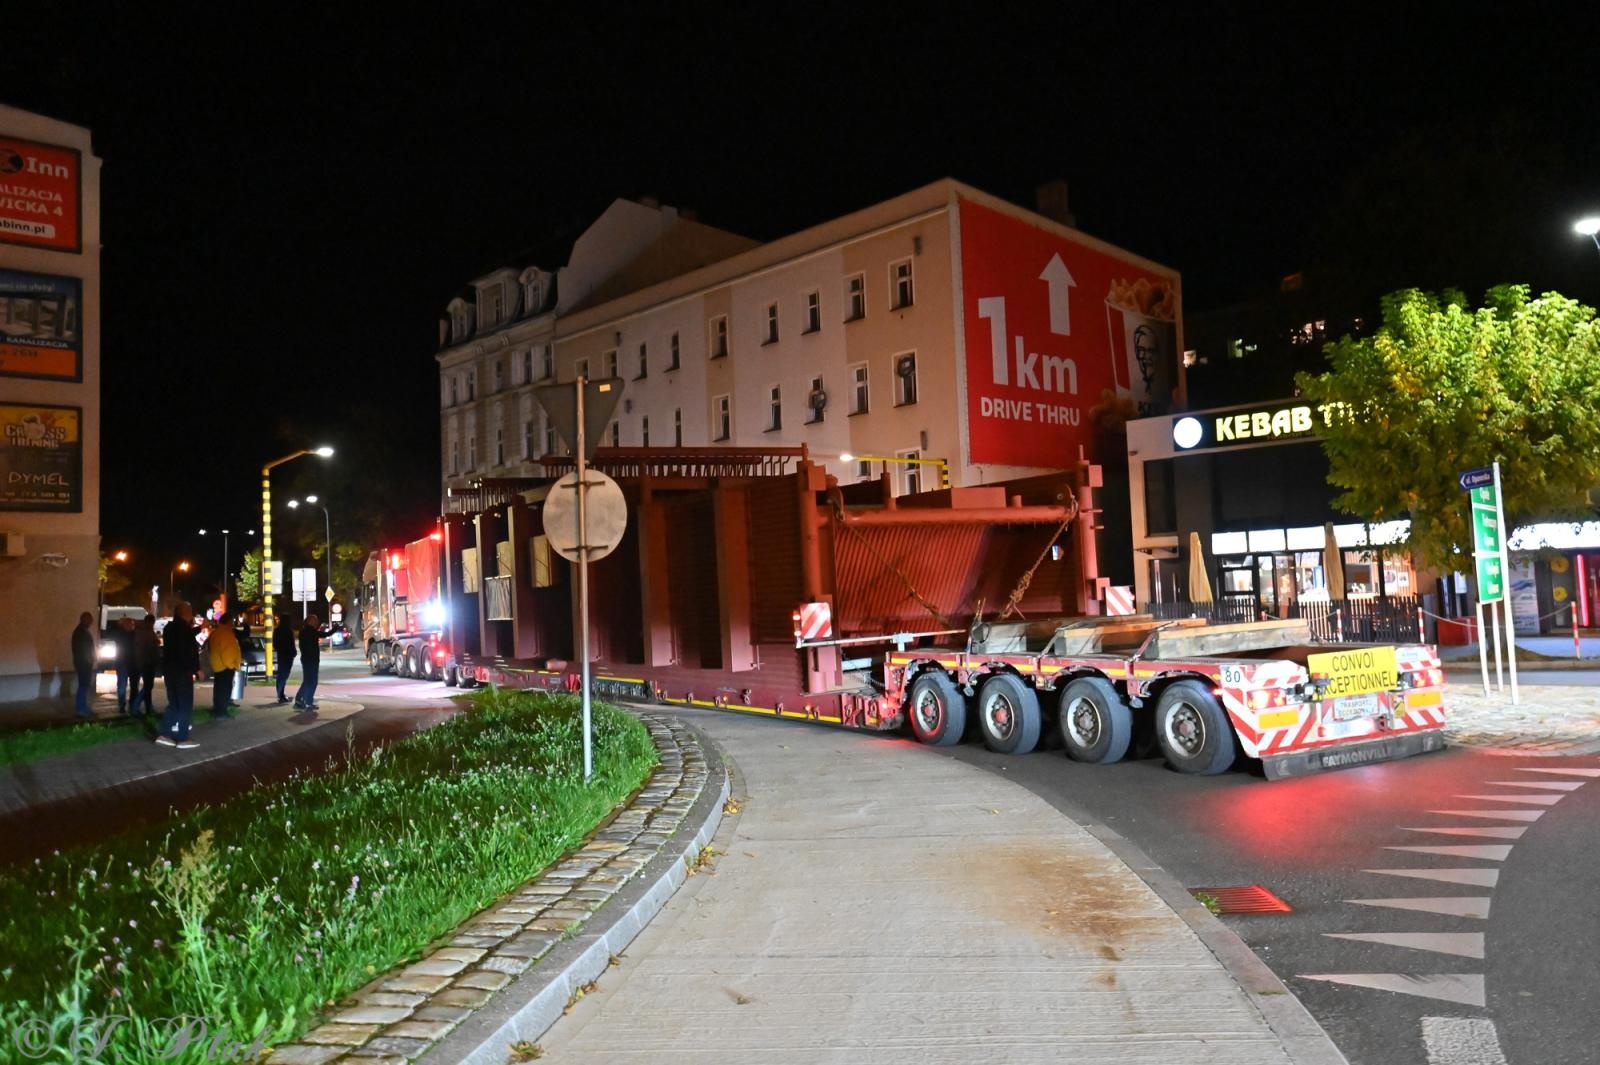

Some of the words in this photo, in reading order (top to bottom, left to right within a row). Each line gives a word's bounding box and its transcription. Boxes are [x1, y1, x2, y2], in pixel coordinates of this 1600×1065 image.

[26, 156, 69, 179] Inn
[53, 206, 64, 217] 4
[981, 396, 1033, 422] DRIVE
[1036, 403, 1081, 427] THRU
[1215, 405, 1313, 442] KEBAB
[8, 471, 70, 486] DYMEL
[1331, 652, 1375, 673] CONVOI
[1225, 670, 1241, 683] 80
